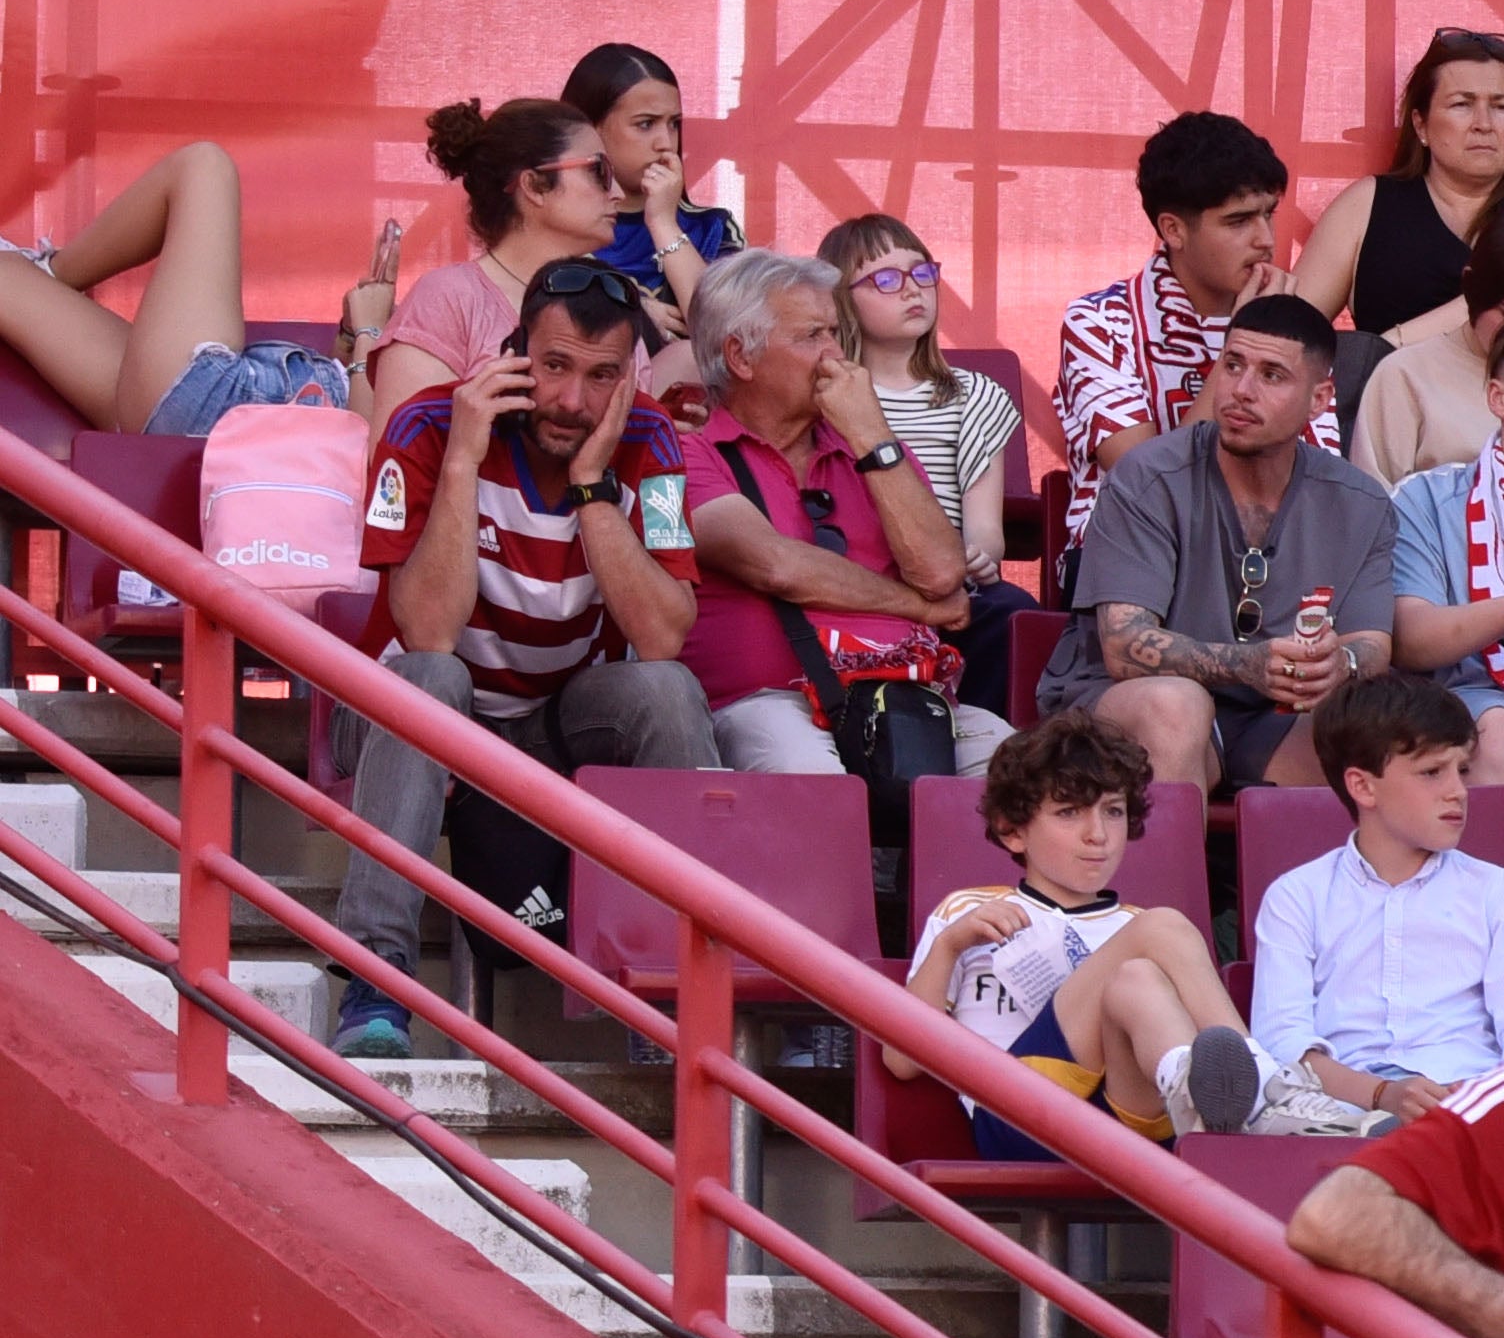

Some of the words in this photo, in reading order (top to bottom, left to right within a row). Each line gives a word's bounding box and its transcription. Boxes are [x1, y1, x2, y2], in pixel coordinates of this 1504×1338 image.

[373, 507, 404, 522] LaLiga
[216, 539, 329, 570] adidas
[519, 908, 565, 927] didas
